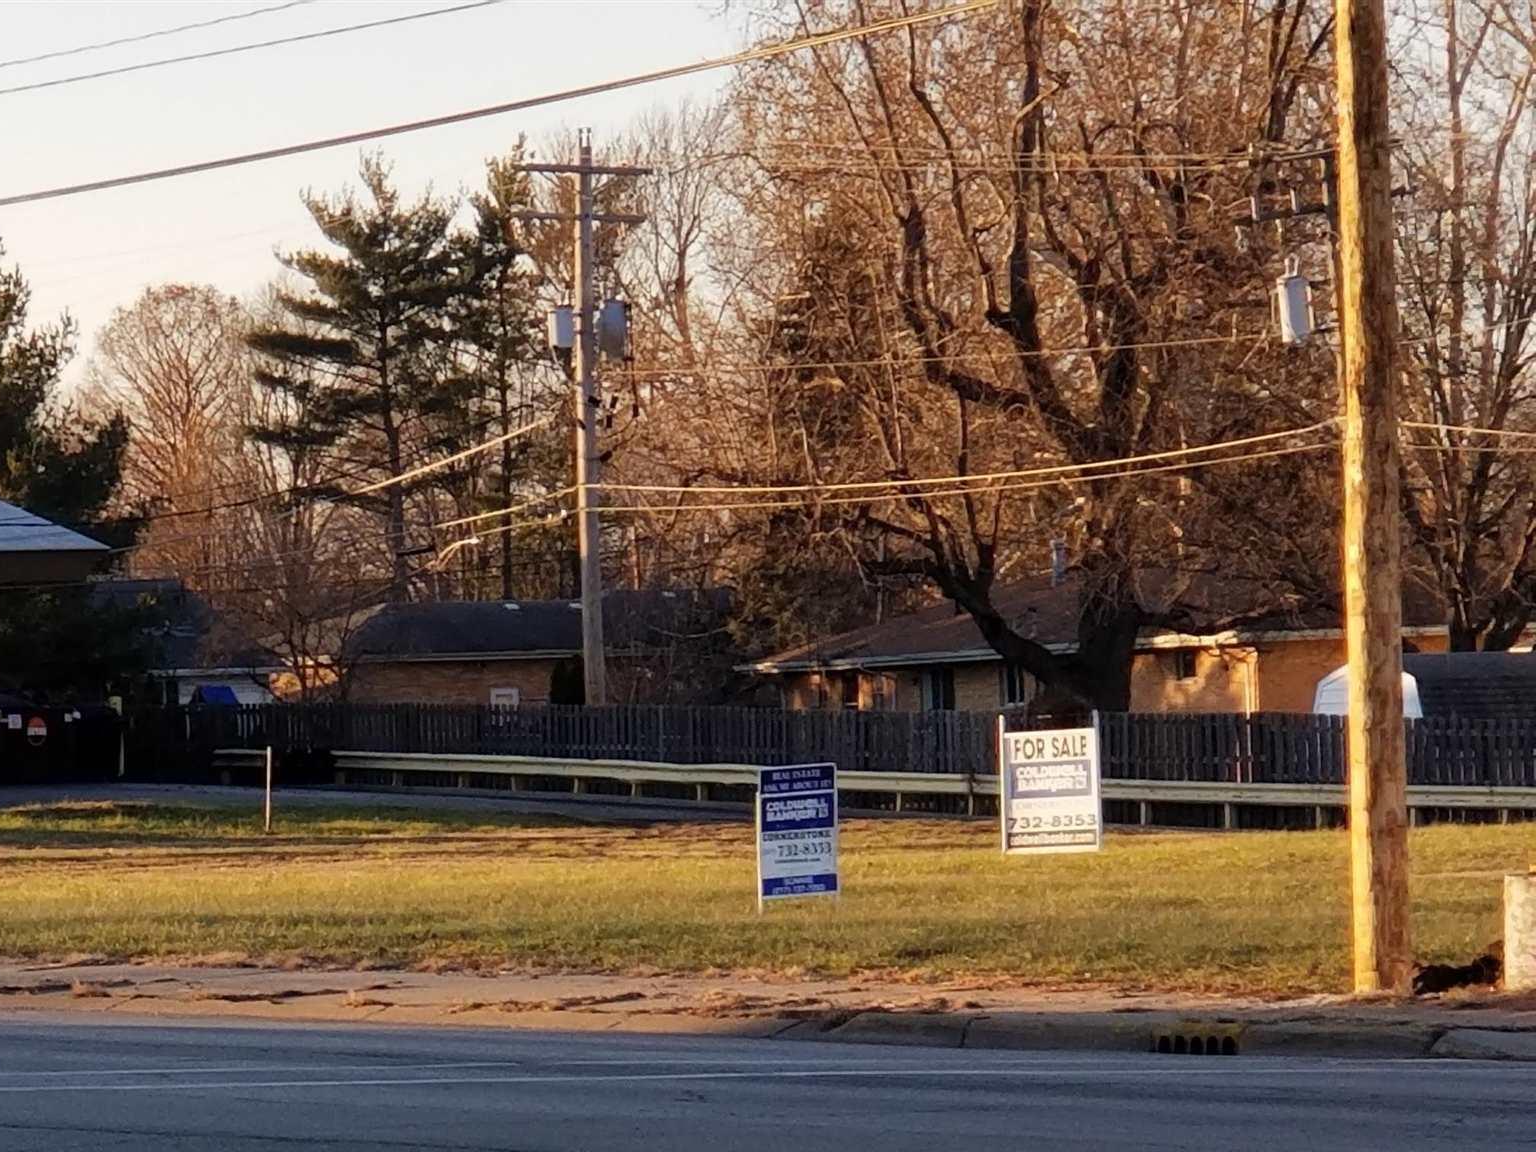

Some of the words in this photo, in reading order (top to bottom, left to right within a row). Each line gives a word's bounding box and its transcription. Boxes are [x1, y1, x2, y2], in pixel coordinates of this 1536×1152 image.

[1013, 738, 1045, 760] FOR
[1051, 735, 1088, 758] SALE
[1016, 764, 1088, 779] COLDWELL
[766, 798, 829, 812] COLDWELL
[1007, 814, 1097, 831] 732-8353
